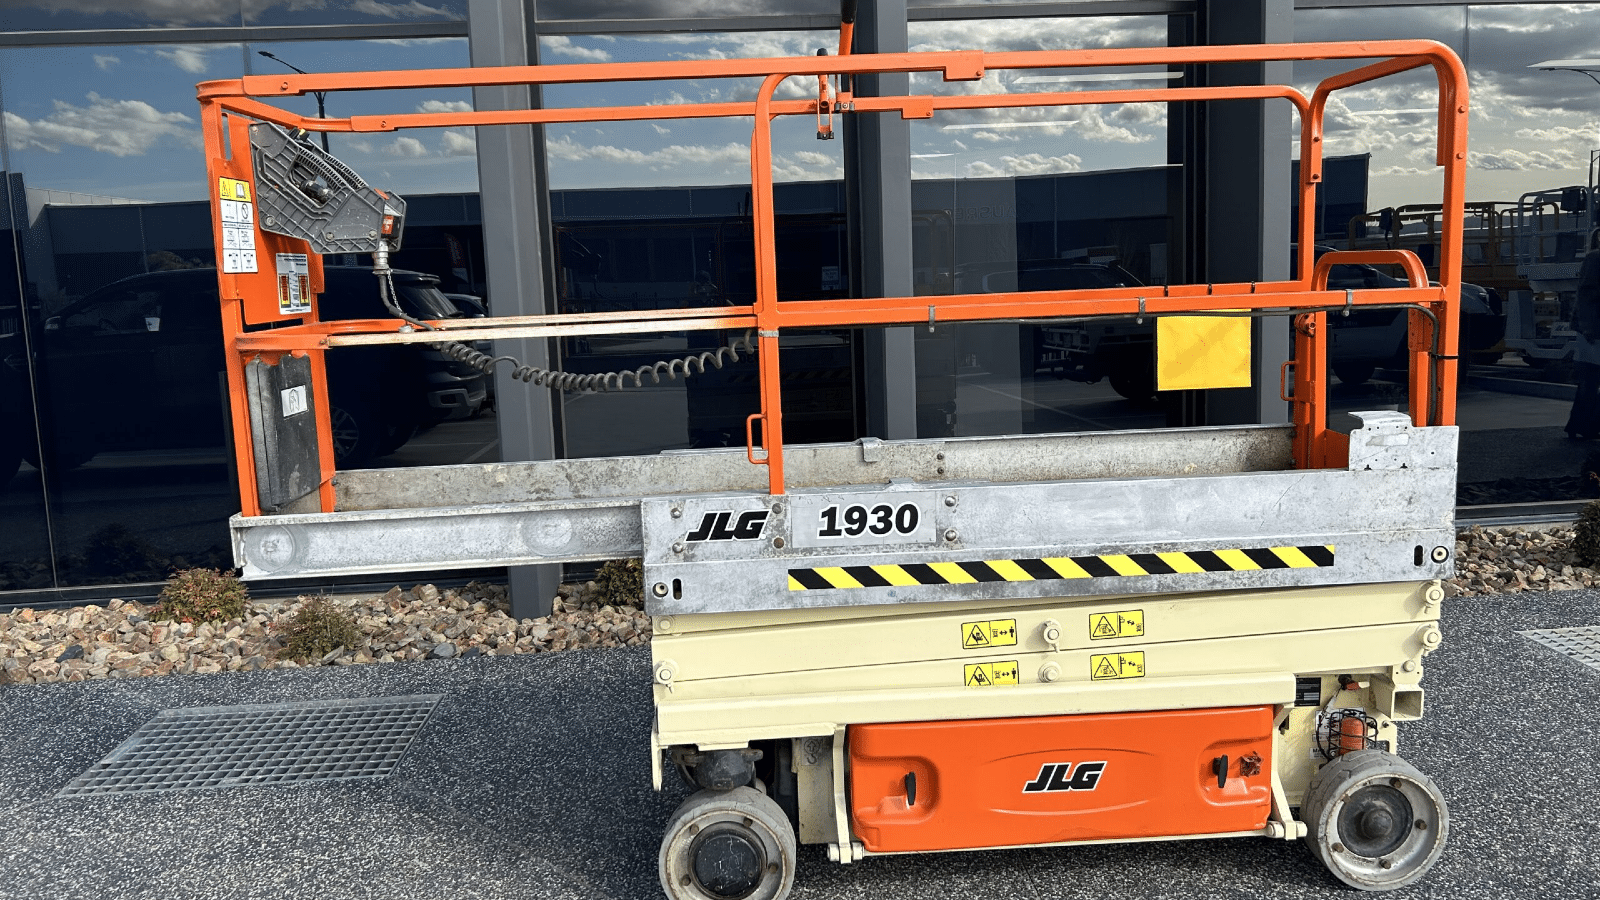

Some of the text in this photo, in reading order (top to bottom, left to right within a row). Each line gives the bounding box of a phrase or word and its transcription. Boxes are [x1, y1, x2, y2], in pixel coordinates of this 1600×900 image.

[685, 511, 770, 542] JLG
[819, 504, 919, 537] 1930
[1023, 762, 1106, 792] JLG
